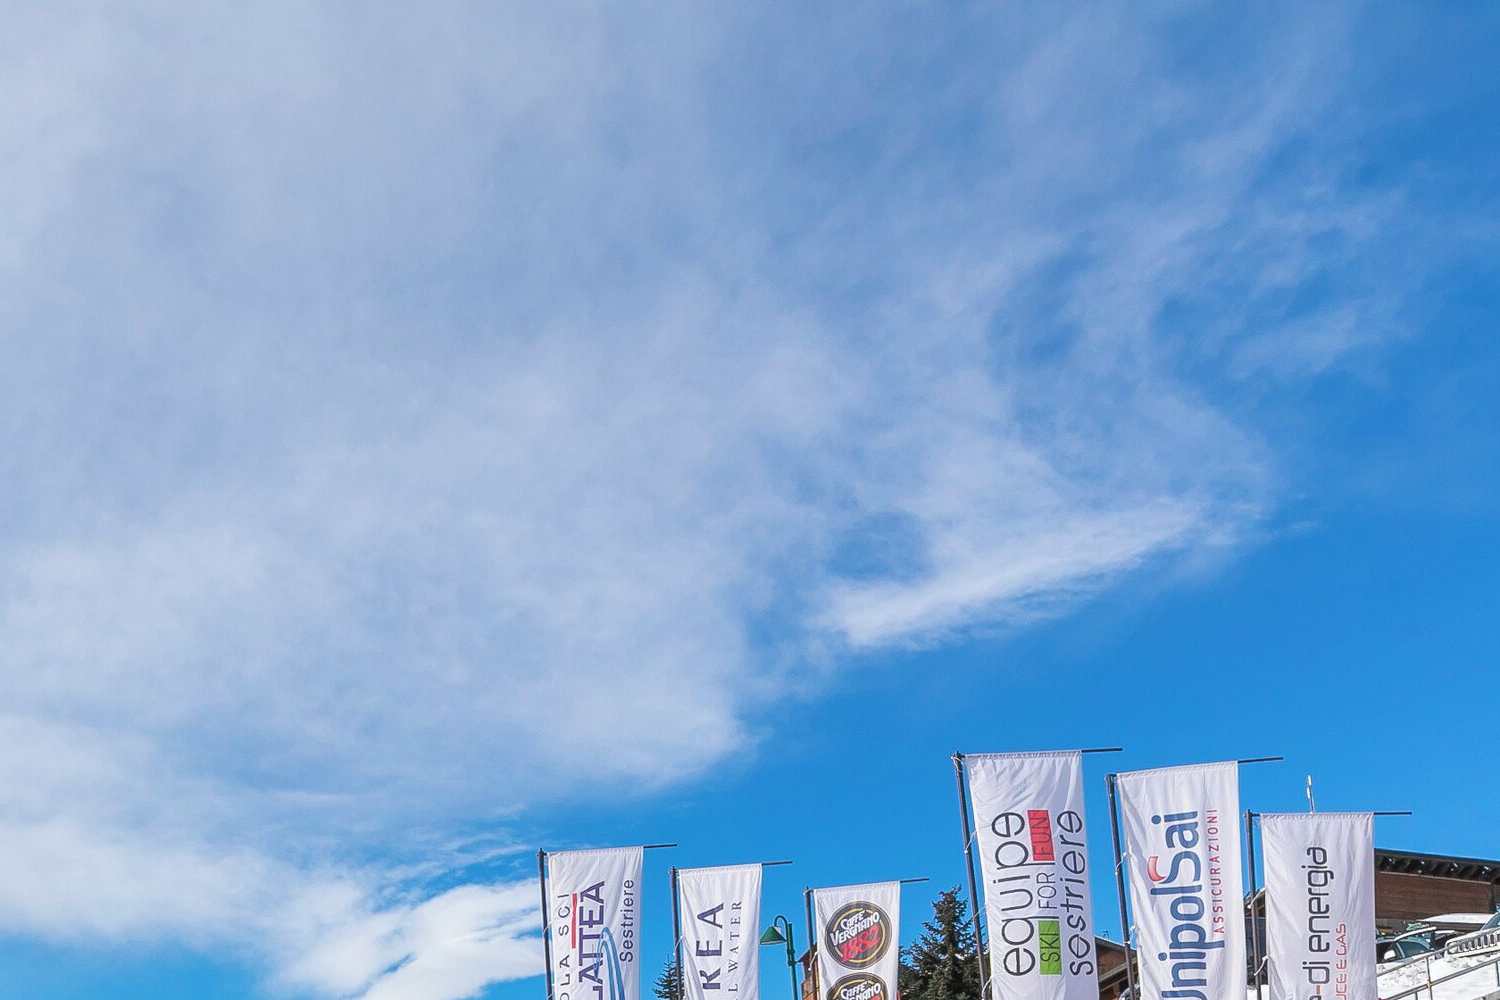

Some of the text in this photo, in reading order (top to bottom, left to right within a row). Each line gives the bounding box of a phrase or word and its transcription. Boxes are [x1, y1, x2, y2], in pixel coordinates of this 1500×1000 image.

[991, 811, 1059, 977] equipe
[1030, 817, 1061, 963] SKI FOR FUN
[1057, 810, 1094, 976] sestriere
[1207, 809, 1225, 934] ASSICURAZIONI
[1301, 846, 1334, 953] energia
[557, 893, 571, 936] SCI
[619, 879, 635, 962] Sestriere
[728, 900, 743, 974] WATER
[829, 911, 880, 946] VERGNANO
[841, 924, 881, 963] 1882
[1336, 923, 1347, 956] GAS
